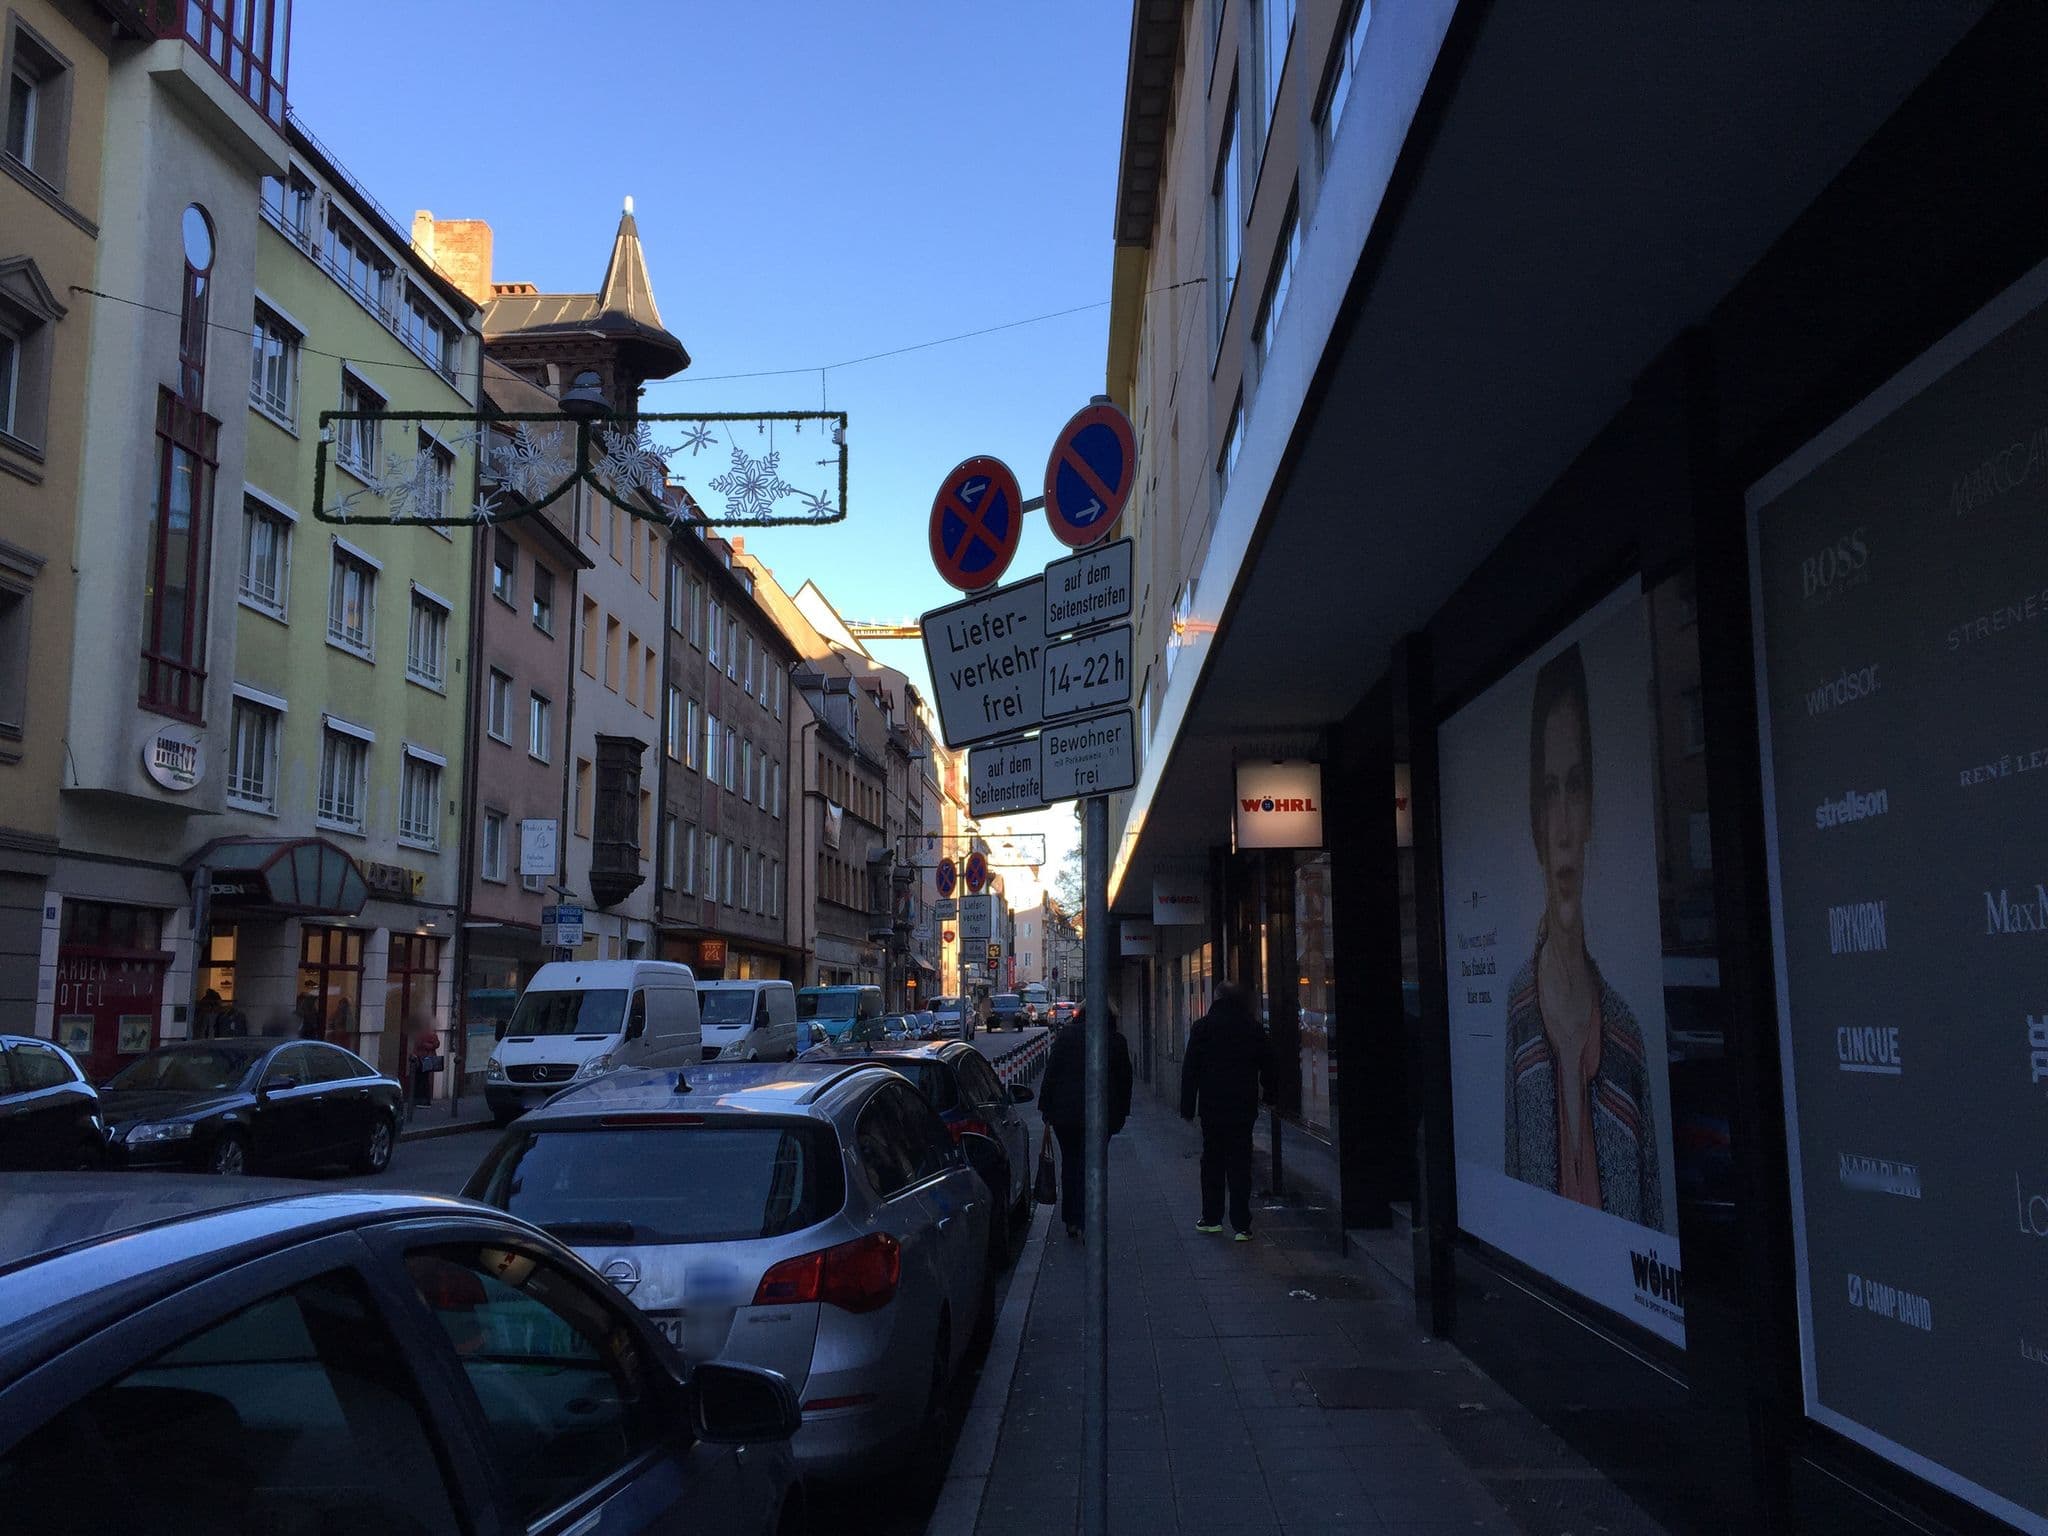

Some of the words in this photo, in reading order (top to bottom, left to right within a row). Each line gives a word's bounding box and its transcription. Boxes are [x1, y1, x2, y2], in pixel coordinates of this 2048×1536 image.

[1064, 569, 1082, 592] auf
[1087, 565, 1110, 586] dem
[1801, 527, 1869, 599] BOSS
[1050, 586, 1125, 622] Seitenstreifen
[947, 613, 1027, 652] Liefer-
[950, 645, 1039, 691] verkehr
[1050, 653, 1109, 696] 14-22
[1114, 650, 1124, 681] h
[983, 686, 1023, 722] frei
[1050, 727, 1121, 755] Bewohner
[988, 757, 1004, 777] auf
[1010, 755, 1031, 774] dem
[1075, 764, 1099, 786] frei
[1959, 755, 2012, 786] RENÉ
[1241, 796, 1317, 812] WÖHRL
[1815, 790, 1889, 830] strellson
[1829, 900, 1888, 954] DRYKORN
[1837, 1025, 1901, 1065] CINQUE
[1866, 1279, 1896, 1319] CAMP
[1898, 1290, 1932, 1332] DAVID
